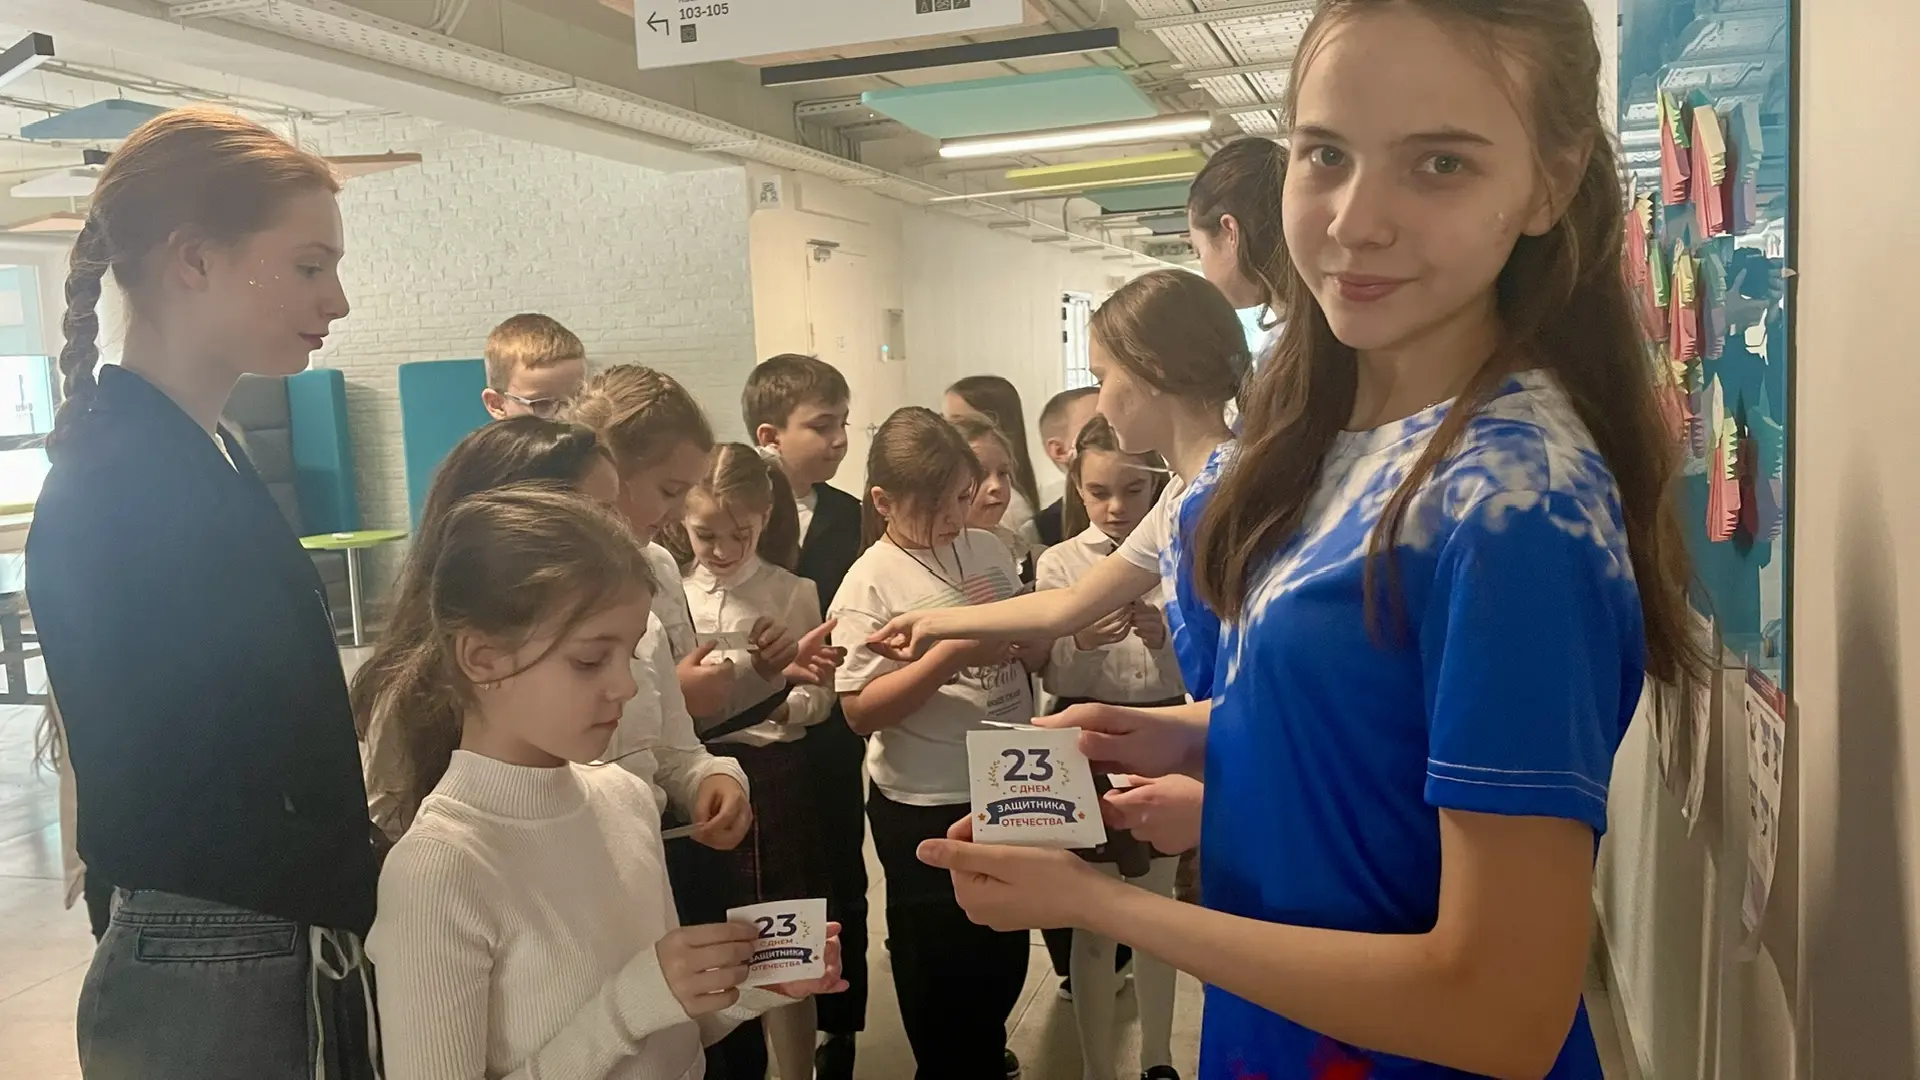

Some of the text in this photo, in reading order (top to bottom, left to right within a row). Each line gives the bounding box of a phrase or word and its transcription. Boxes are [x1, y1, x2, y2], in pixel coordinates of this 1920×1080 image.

[679, 2, 729, 20] 103-105
[1001, 748, 1054, 782] 23
[1010, 784, 1051, 794] С ДНЕМ
[997, 800, 1067, 813] ЗАЩИТНИКА
[1001, 817, 1064, 828] ОТЕЧЕСТВА
[754, 913, 797, 939] 23
[751, 949, 804, 961] АЩИТНИКА
[751, 961, 801, 971] ОТЕЧЕСТВА
